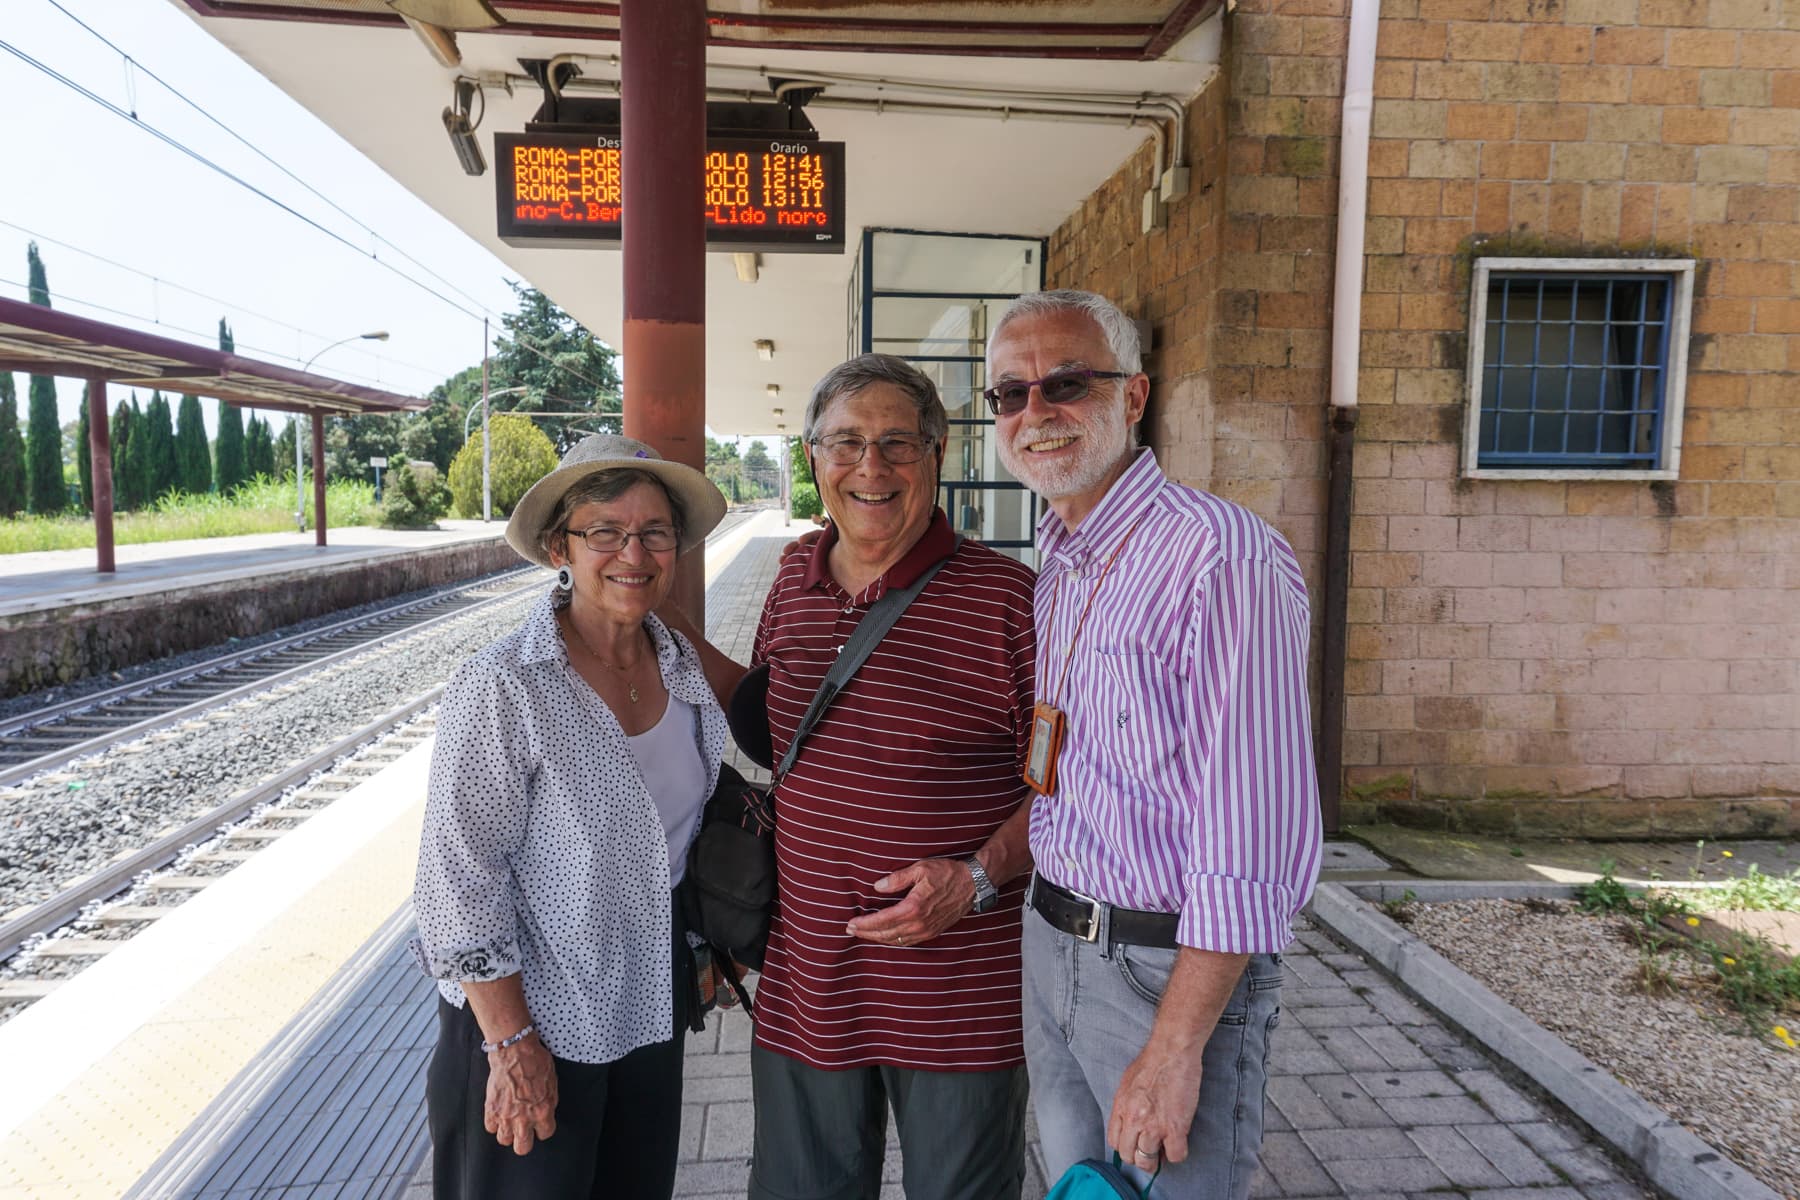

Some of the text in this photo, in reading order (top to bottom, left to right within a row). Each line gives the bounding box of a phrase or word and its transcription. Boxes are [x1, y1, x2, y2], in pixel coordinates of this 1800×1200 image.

[598, 137, 621, 148] Des
[770, 142, 808, 154] Orario
[514, 147, 621, 167] ROMA-POR
[763, 154, 822, 172] 12:41
[515, 166, 621, 185] ROMA-POR
[763, 172, 824, 190] 12:56
[516, 184, 621, 203] ROMA-POR
[763, 190, 822, 208] 13:11
